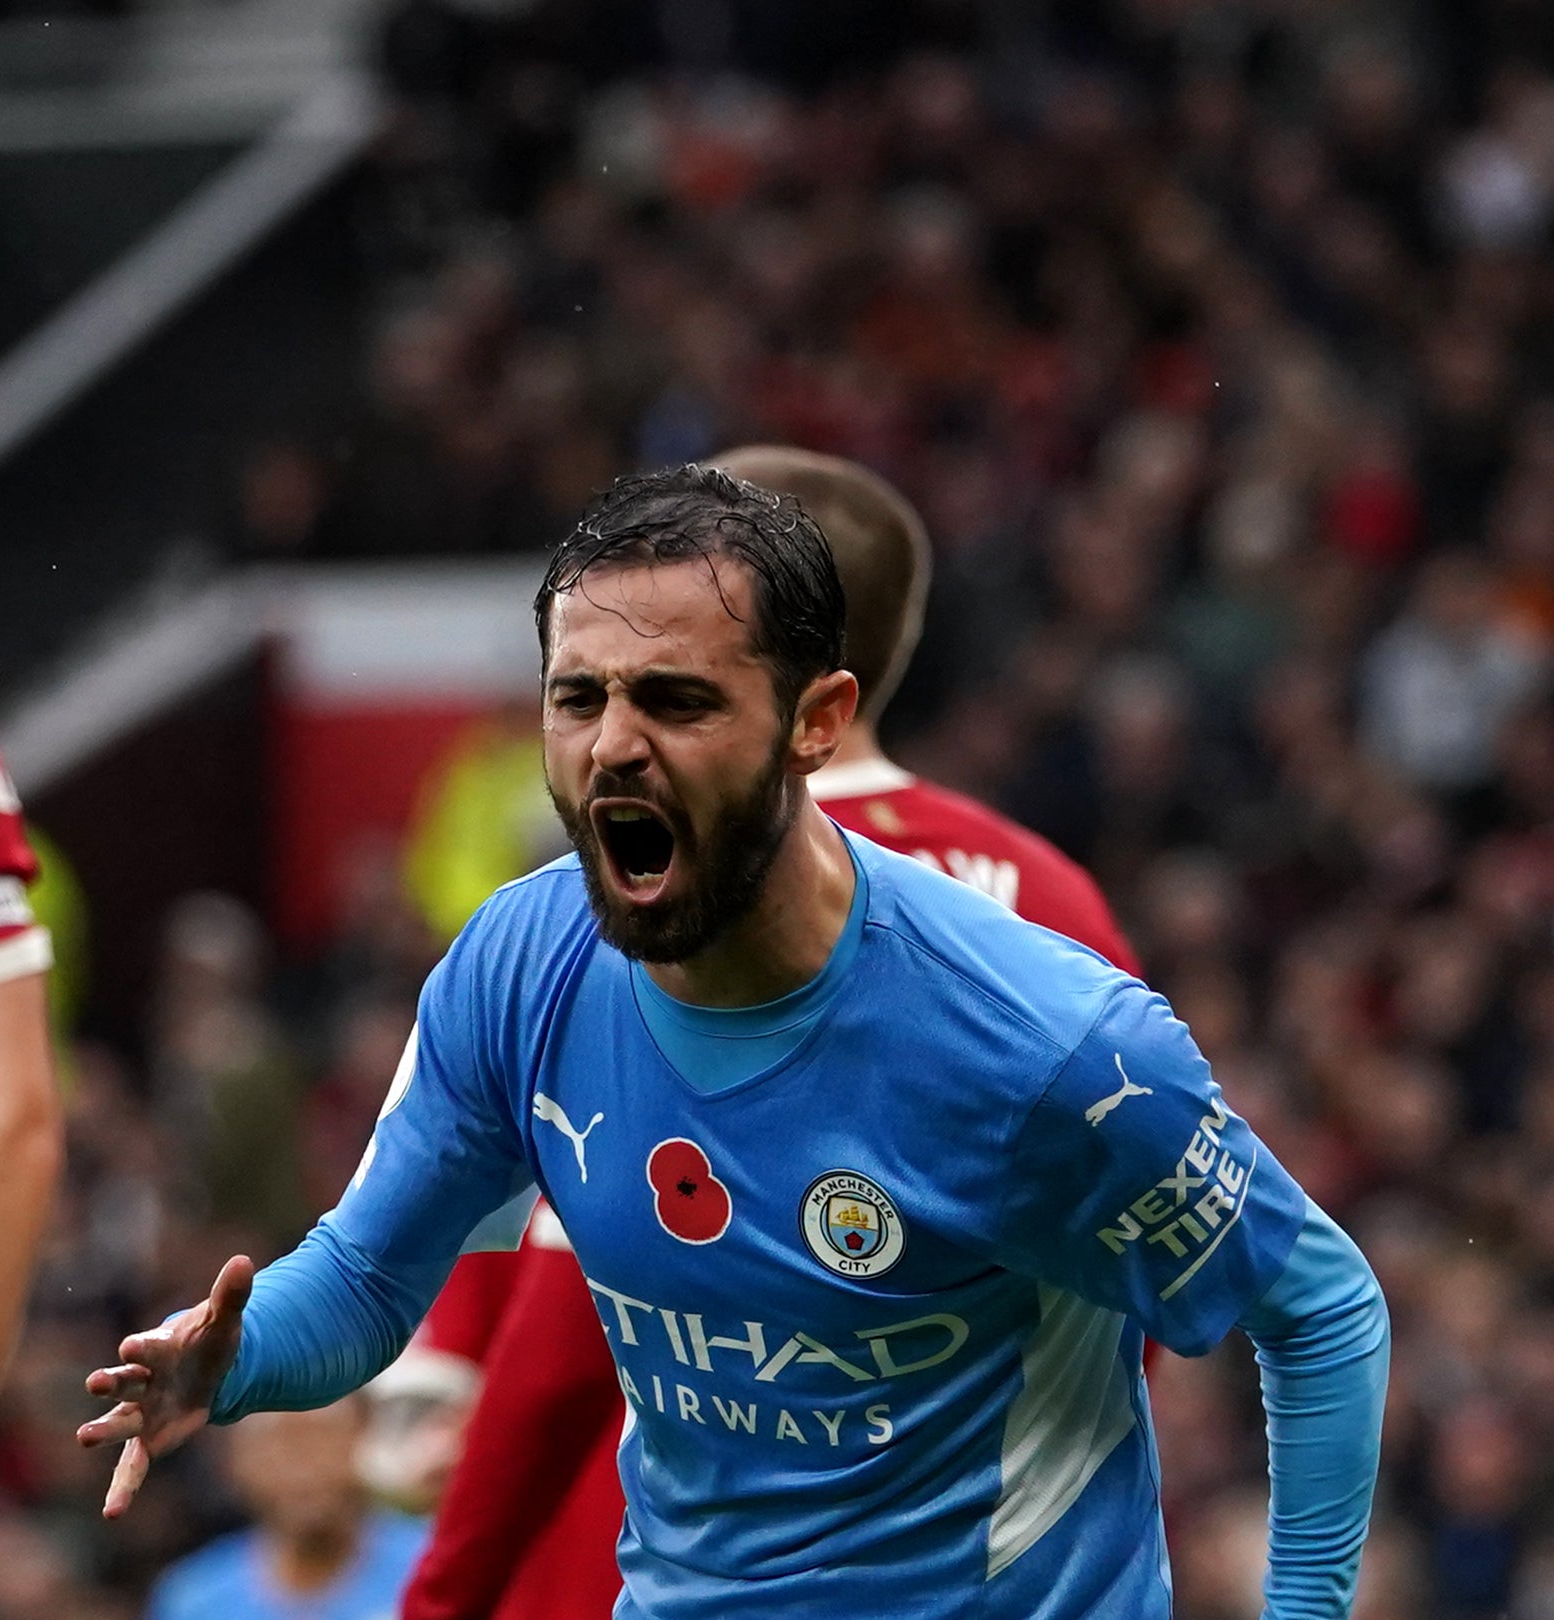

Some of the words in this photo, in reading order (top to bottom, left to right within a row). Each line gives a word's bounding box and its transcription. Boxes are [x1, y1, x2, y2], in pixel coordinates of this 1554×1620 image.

[812, 1179, 894, 1220] MANCHESTER
[1096, 1096, 1229, 1256] NEXEN
[1146, 1149, 1244, 1258] TIRE
[838, 1260, 871, 1273] CITY
[587, 1276, 970, 1382] TIHAD
[619, 1366, 894, 1447] AIRWAYS
